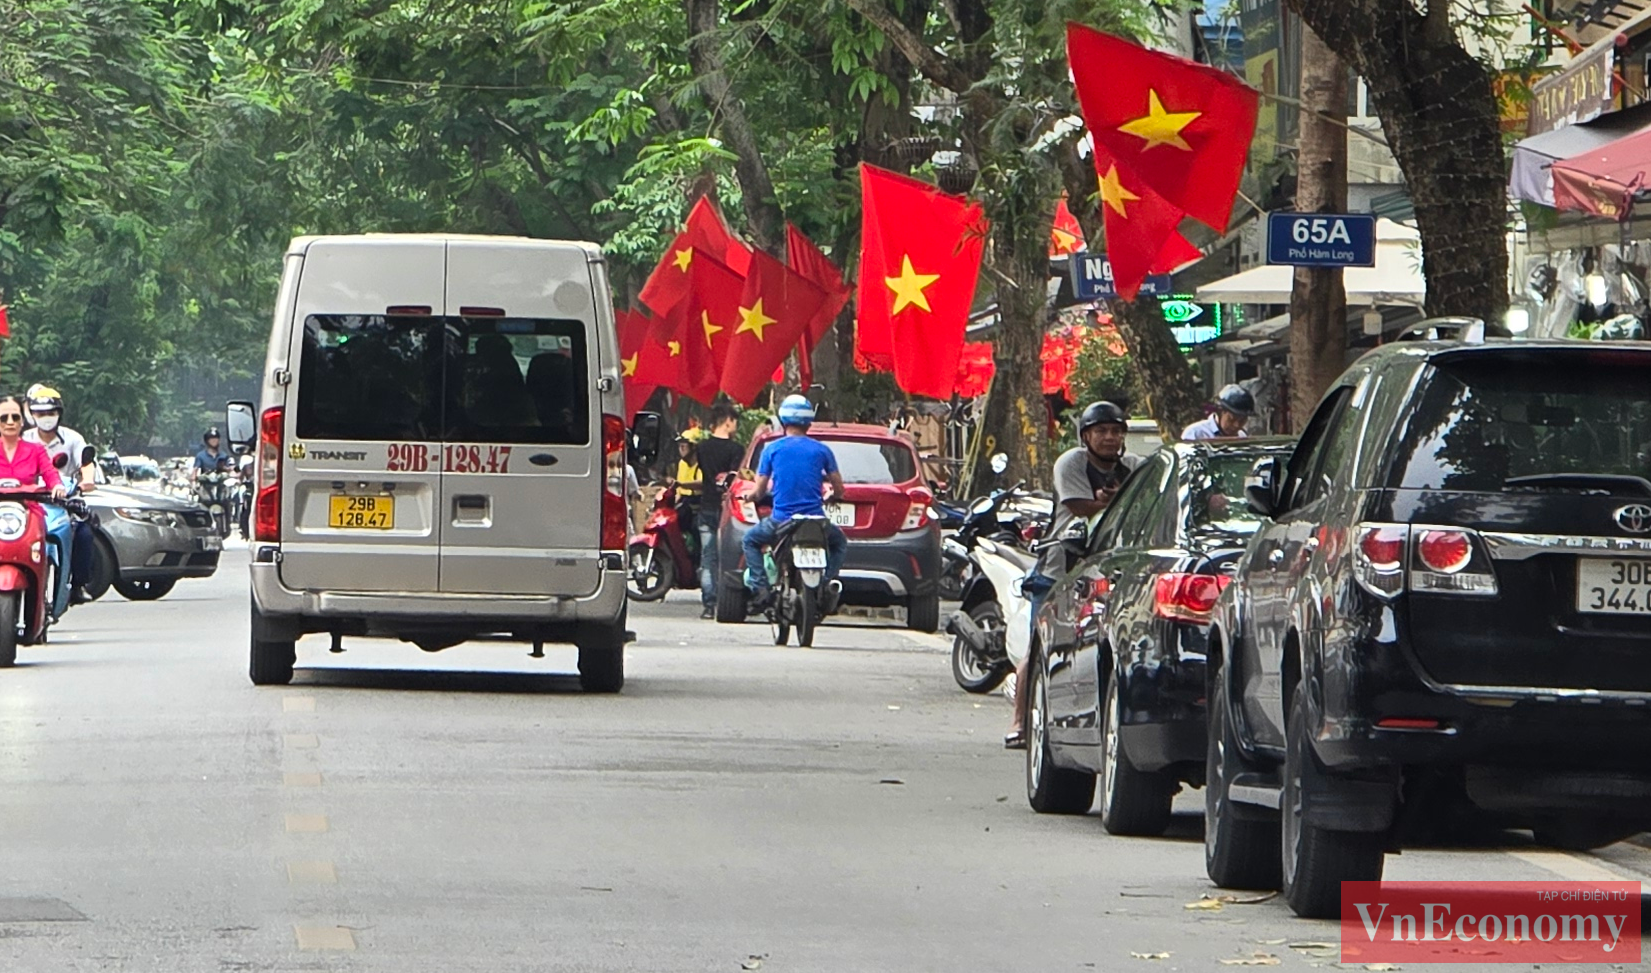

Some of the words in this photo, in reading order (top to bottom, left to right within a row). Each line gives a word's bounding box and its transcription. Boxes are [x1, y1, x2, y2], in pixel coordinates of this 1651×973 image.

[1292, 218, 1351, 244] 65A
[1288, 246, 1307, 259] Phố
[1309, 248, 1330, 259] Hàm
[1332, 249, 1355, 262] Long
[1085, 258, 1114, 281] Ng
[309, 450, 368, 461] TRANSIT
[348, 497, 376, 512] 29B
[337, 512, 388, 527] 128.47
